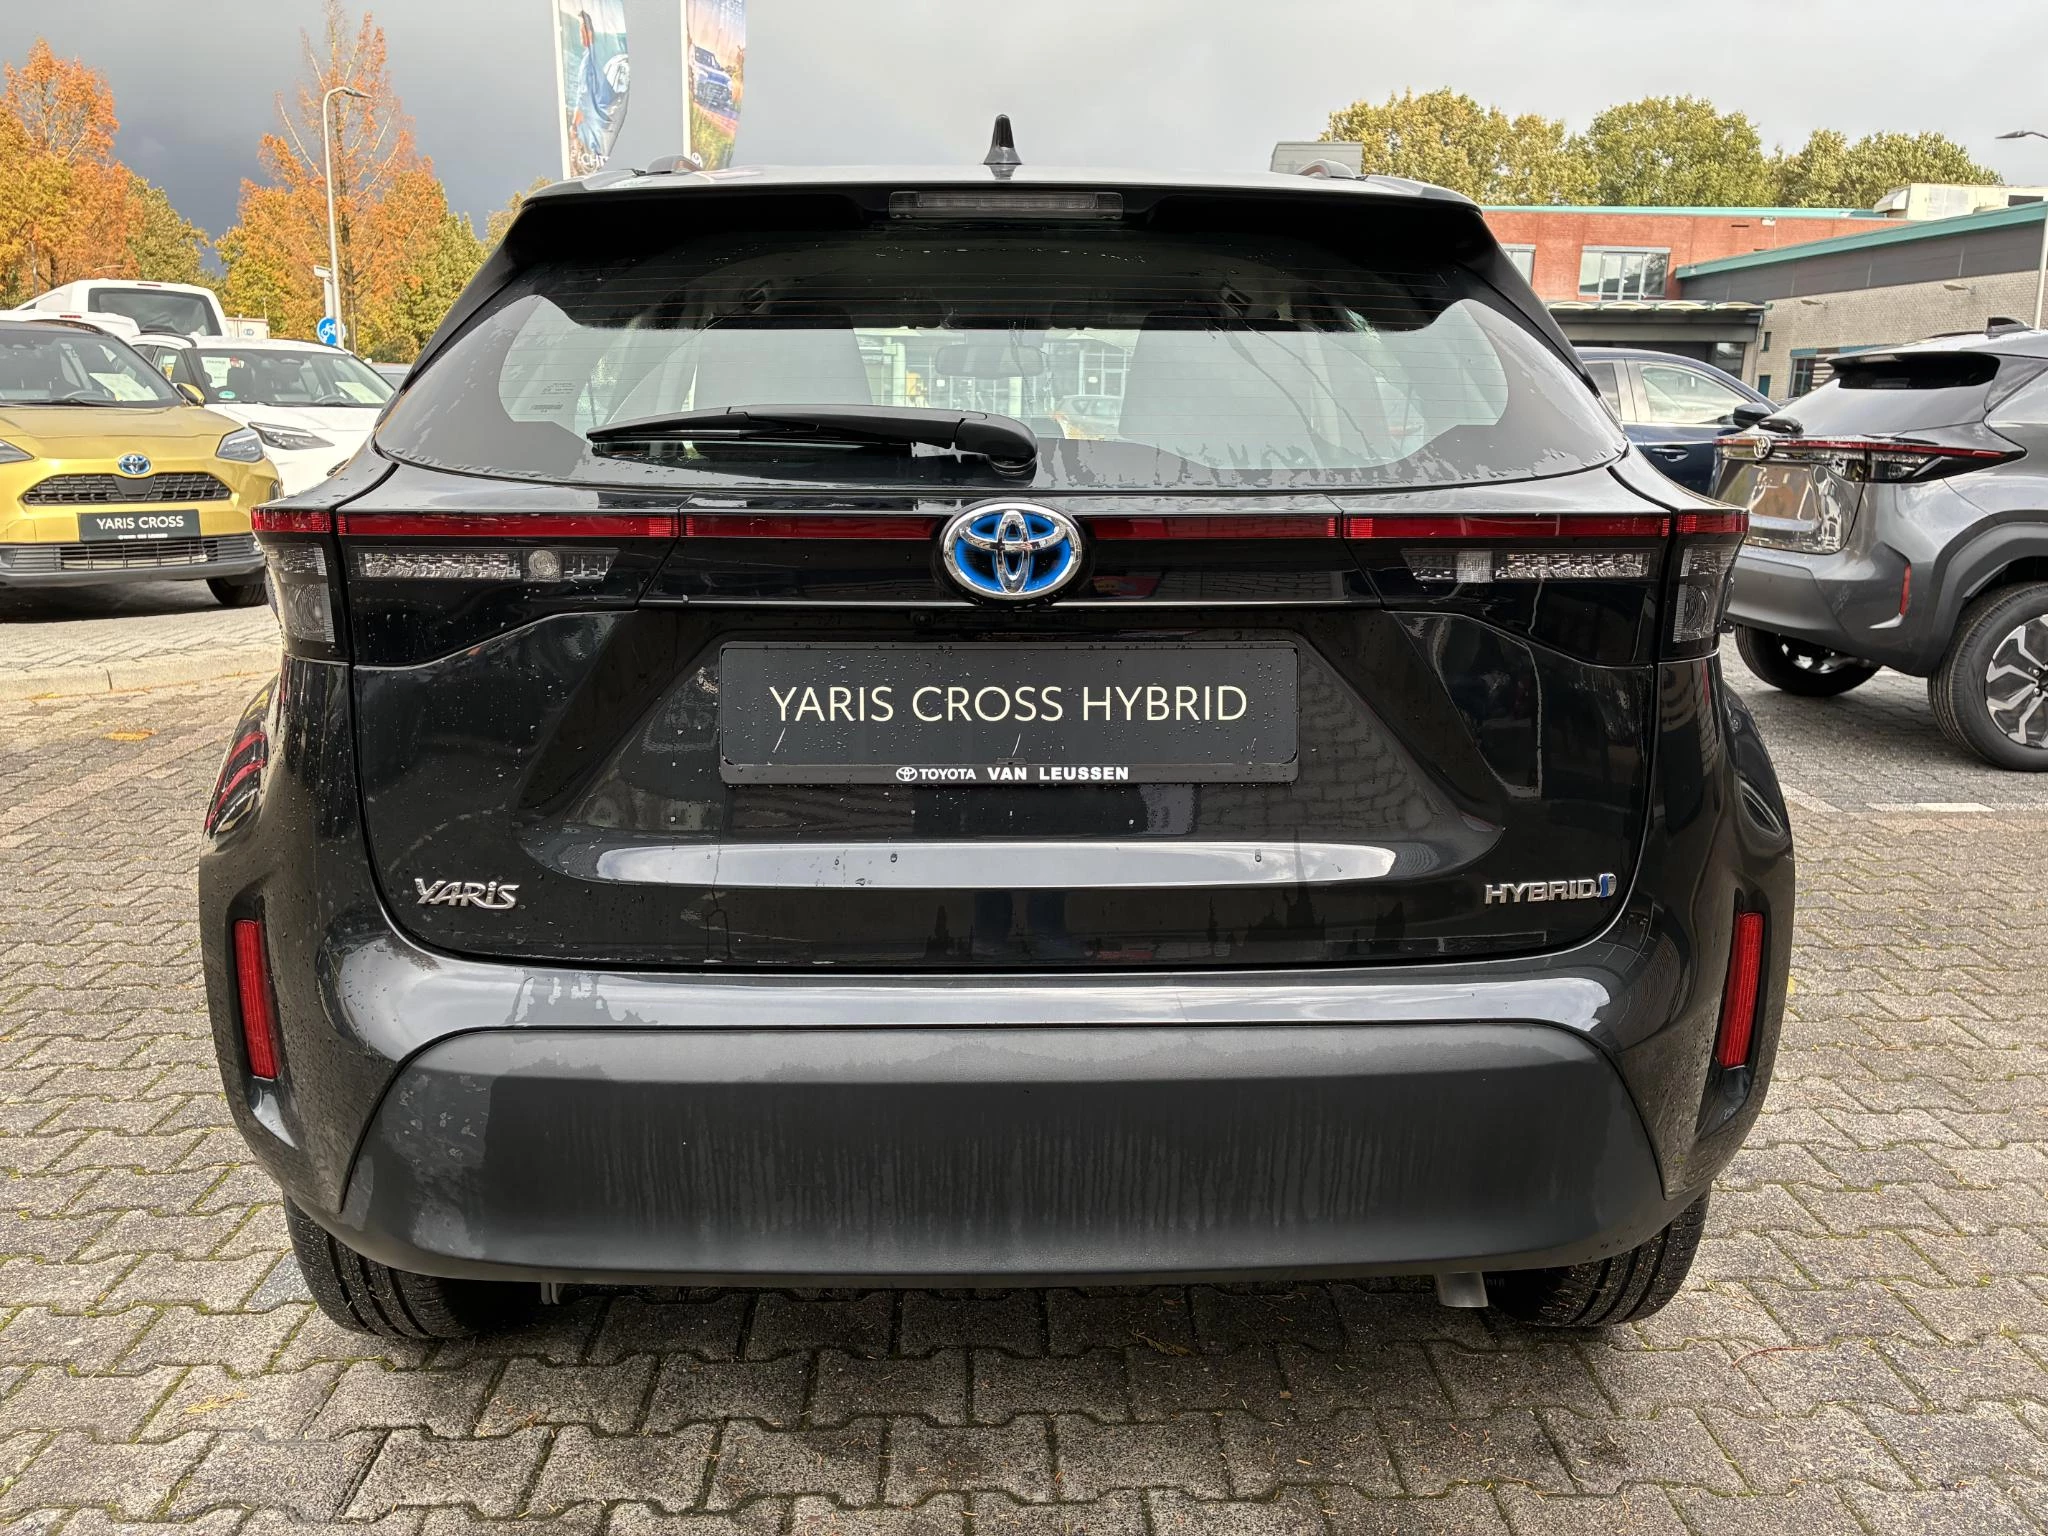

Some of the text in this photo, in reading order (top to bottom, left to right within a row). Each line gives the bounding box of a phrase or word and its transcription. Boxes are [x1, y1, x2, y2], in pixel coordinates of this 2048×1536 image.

[97, 516, 184, 529] YARIS CROSS
[769, 687, 1248, 722] YARIS CROSS HYBRID
[919, 767, 1129, 781] TOYOTA VAN LEUSSEN
[1485, 879, 1598, 904] HYBRID
